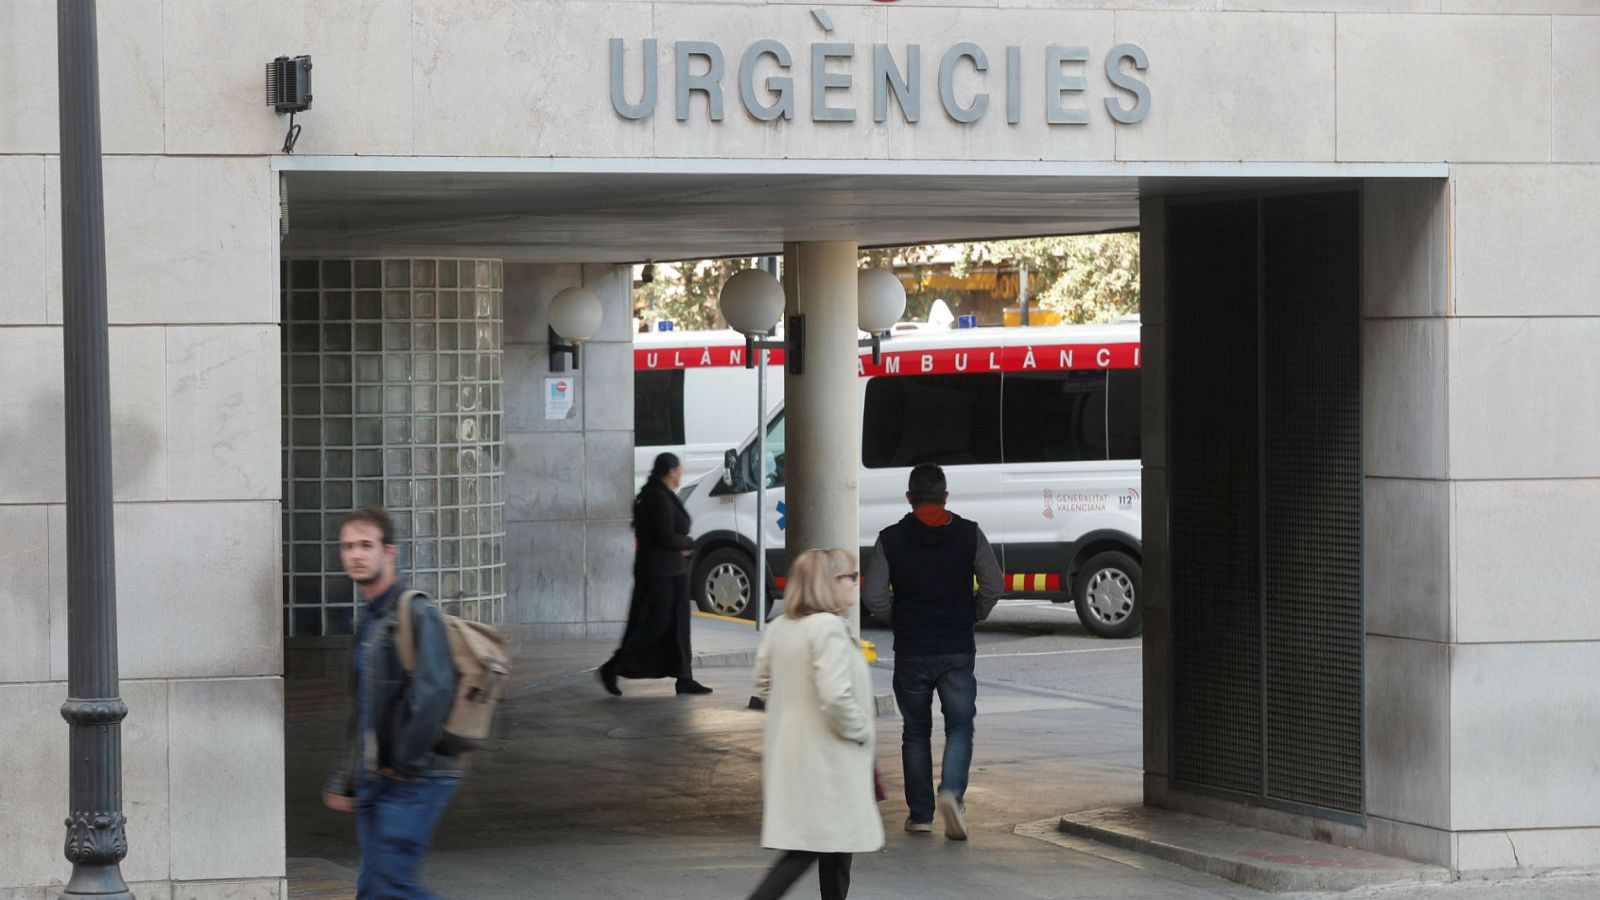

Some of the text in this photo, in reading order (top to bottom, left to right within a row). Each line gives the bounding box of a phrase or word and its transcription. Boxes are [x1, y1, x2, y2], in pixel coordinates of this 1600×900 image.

[609, 9, 1151, 125] URGÈNCIES
[647, 347, 771, 367] ULÀN
[1056, 494, 1108, 503] GENERALITAT
[1119, 496, 1132, 504] 112
[1056, 504, 1106, 512] VALENCIANA
